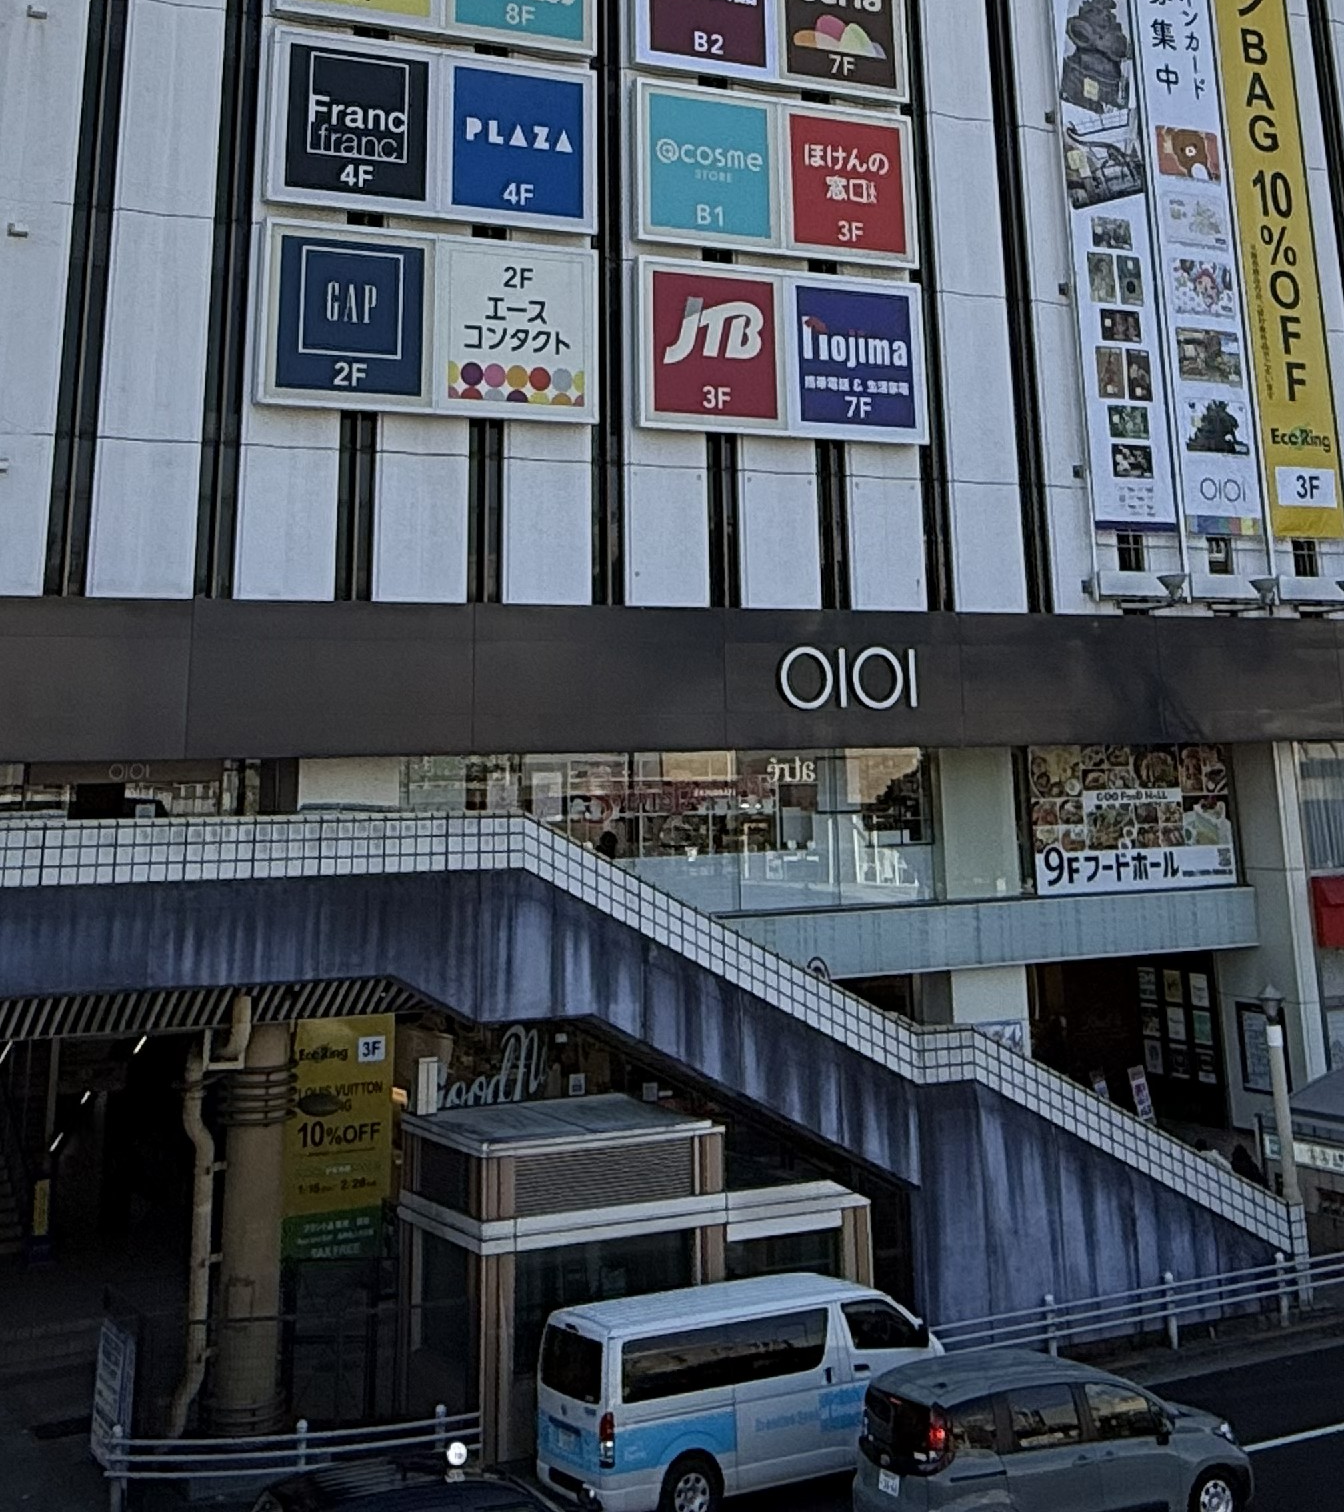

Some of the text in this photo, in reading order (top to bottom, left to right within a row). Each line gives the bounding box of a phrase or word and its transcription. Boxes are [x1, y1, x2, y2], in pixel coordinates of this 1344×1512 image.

[505, 3, 536, 27] 8F
[692, 30, 724, 56] B2
[829, 54, 855, 76] 7F
[309, 95, 406, 135] Franc
[317, 125, 399, 161] franc
[465, 116, 573, 154] PLAZA
[656, 138, 764, 173] @cosme
[803, 142, 889, 176] ほけんの
[340, 164, 373, 189] 4F
[503, 182, 534, 206] 4F
[696, 203, 725, 228] B1
[837, 220, 864, 242] 3F
[502, 266, 534, 290] 2F
[326, 281, 377, 326] GAP
[485, 296, 547, 325] エース
[463, 325, 571, 355] コンタクト
[664, 296, 764, 364] JTB
[334, 362, 367, 387] 2F
[701, 386, 732, 410] 3F
[844, 395, 872, 419] 7F
[1296, 475, 1320, 499] 3F
[362, 1040, 382, 1058] 3F
[334, 1081, 384, 1098] VUITTON
